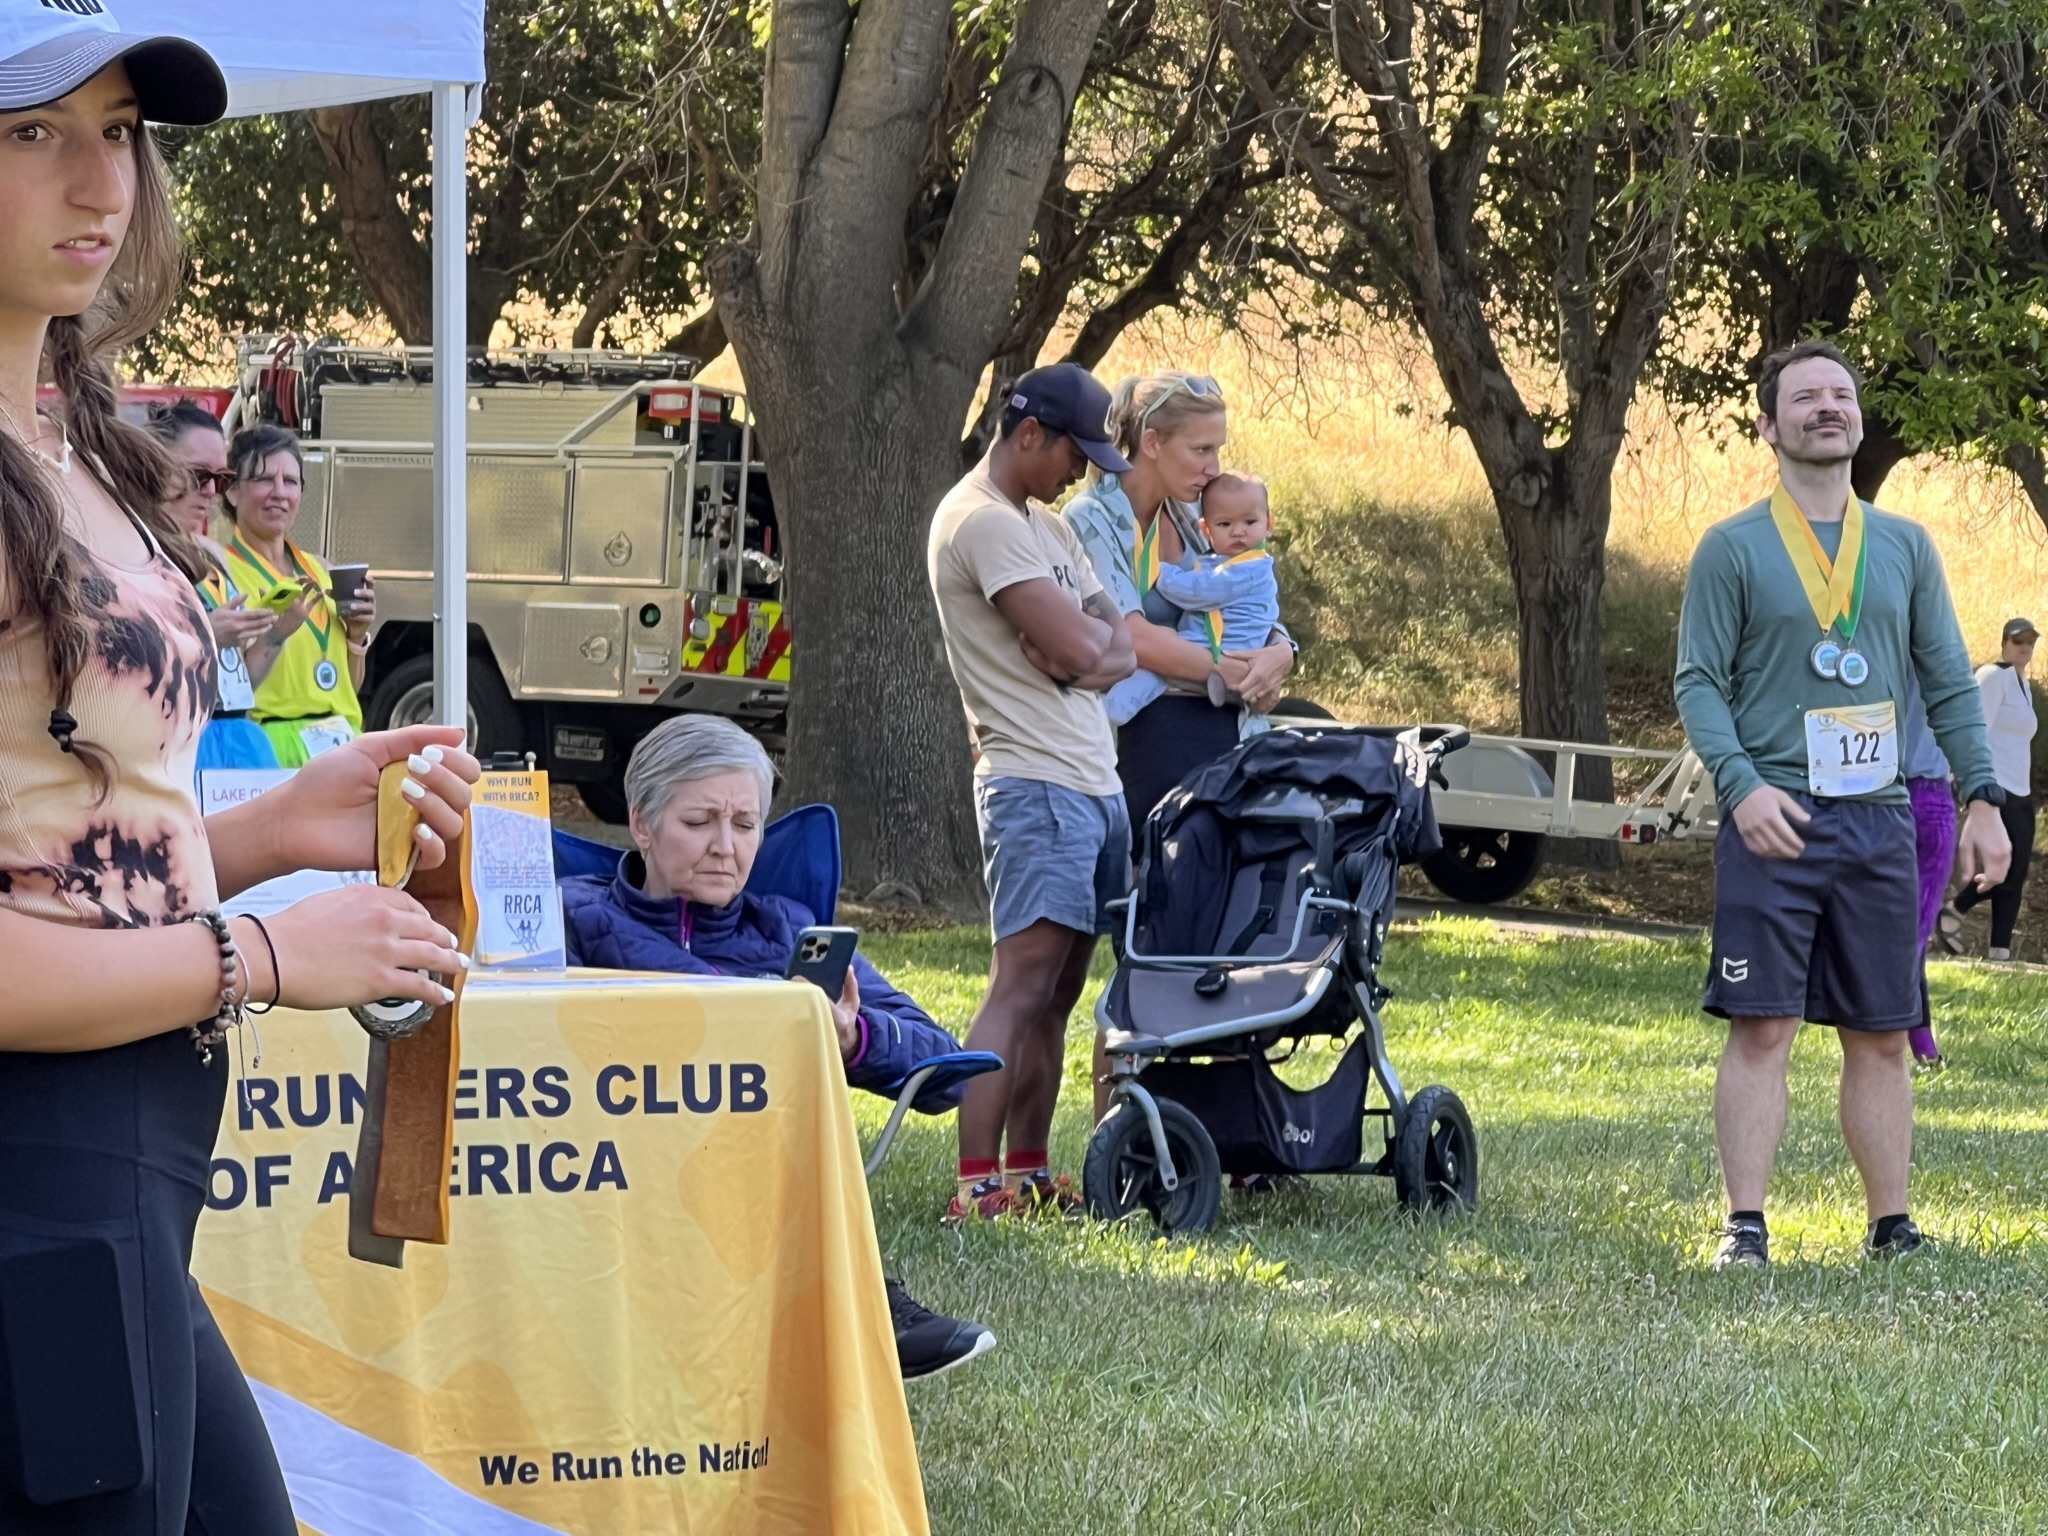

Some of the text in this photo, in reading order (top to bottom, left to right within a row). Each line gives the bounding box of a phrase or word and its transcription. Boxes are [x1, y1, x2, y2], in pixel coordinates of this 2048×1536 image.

[1839, 731, 1880, 766] 122
[212, 788, 246, 801] LAKE
[487, 776, 532, 787] WHY RUN
[483, 791, 540, 802] WITH RRCA?
[504, 894, 542, 914] RRCA
[237, 1063, 768, 1131] RUNERS CLUB
[205, 1141, 628, 1211] OF ARICA
[479, 1455, 540, 1486] We
[552, 1452, 622, 1482] Run
[631, 1447, 686, 1477] the
